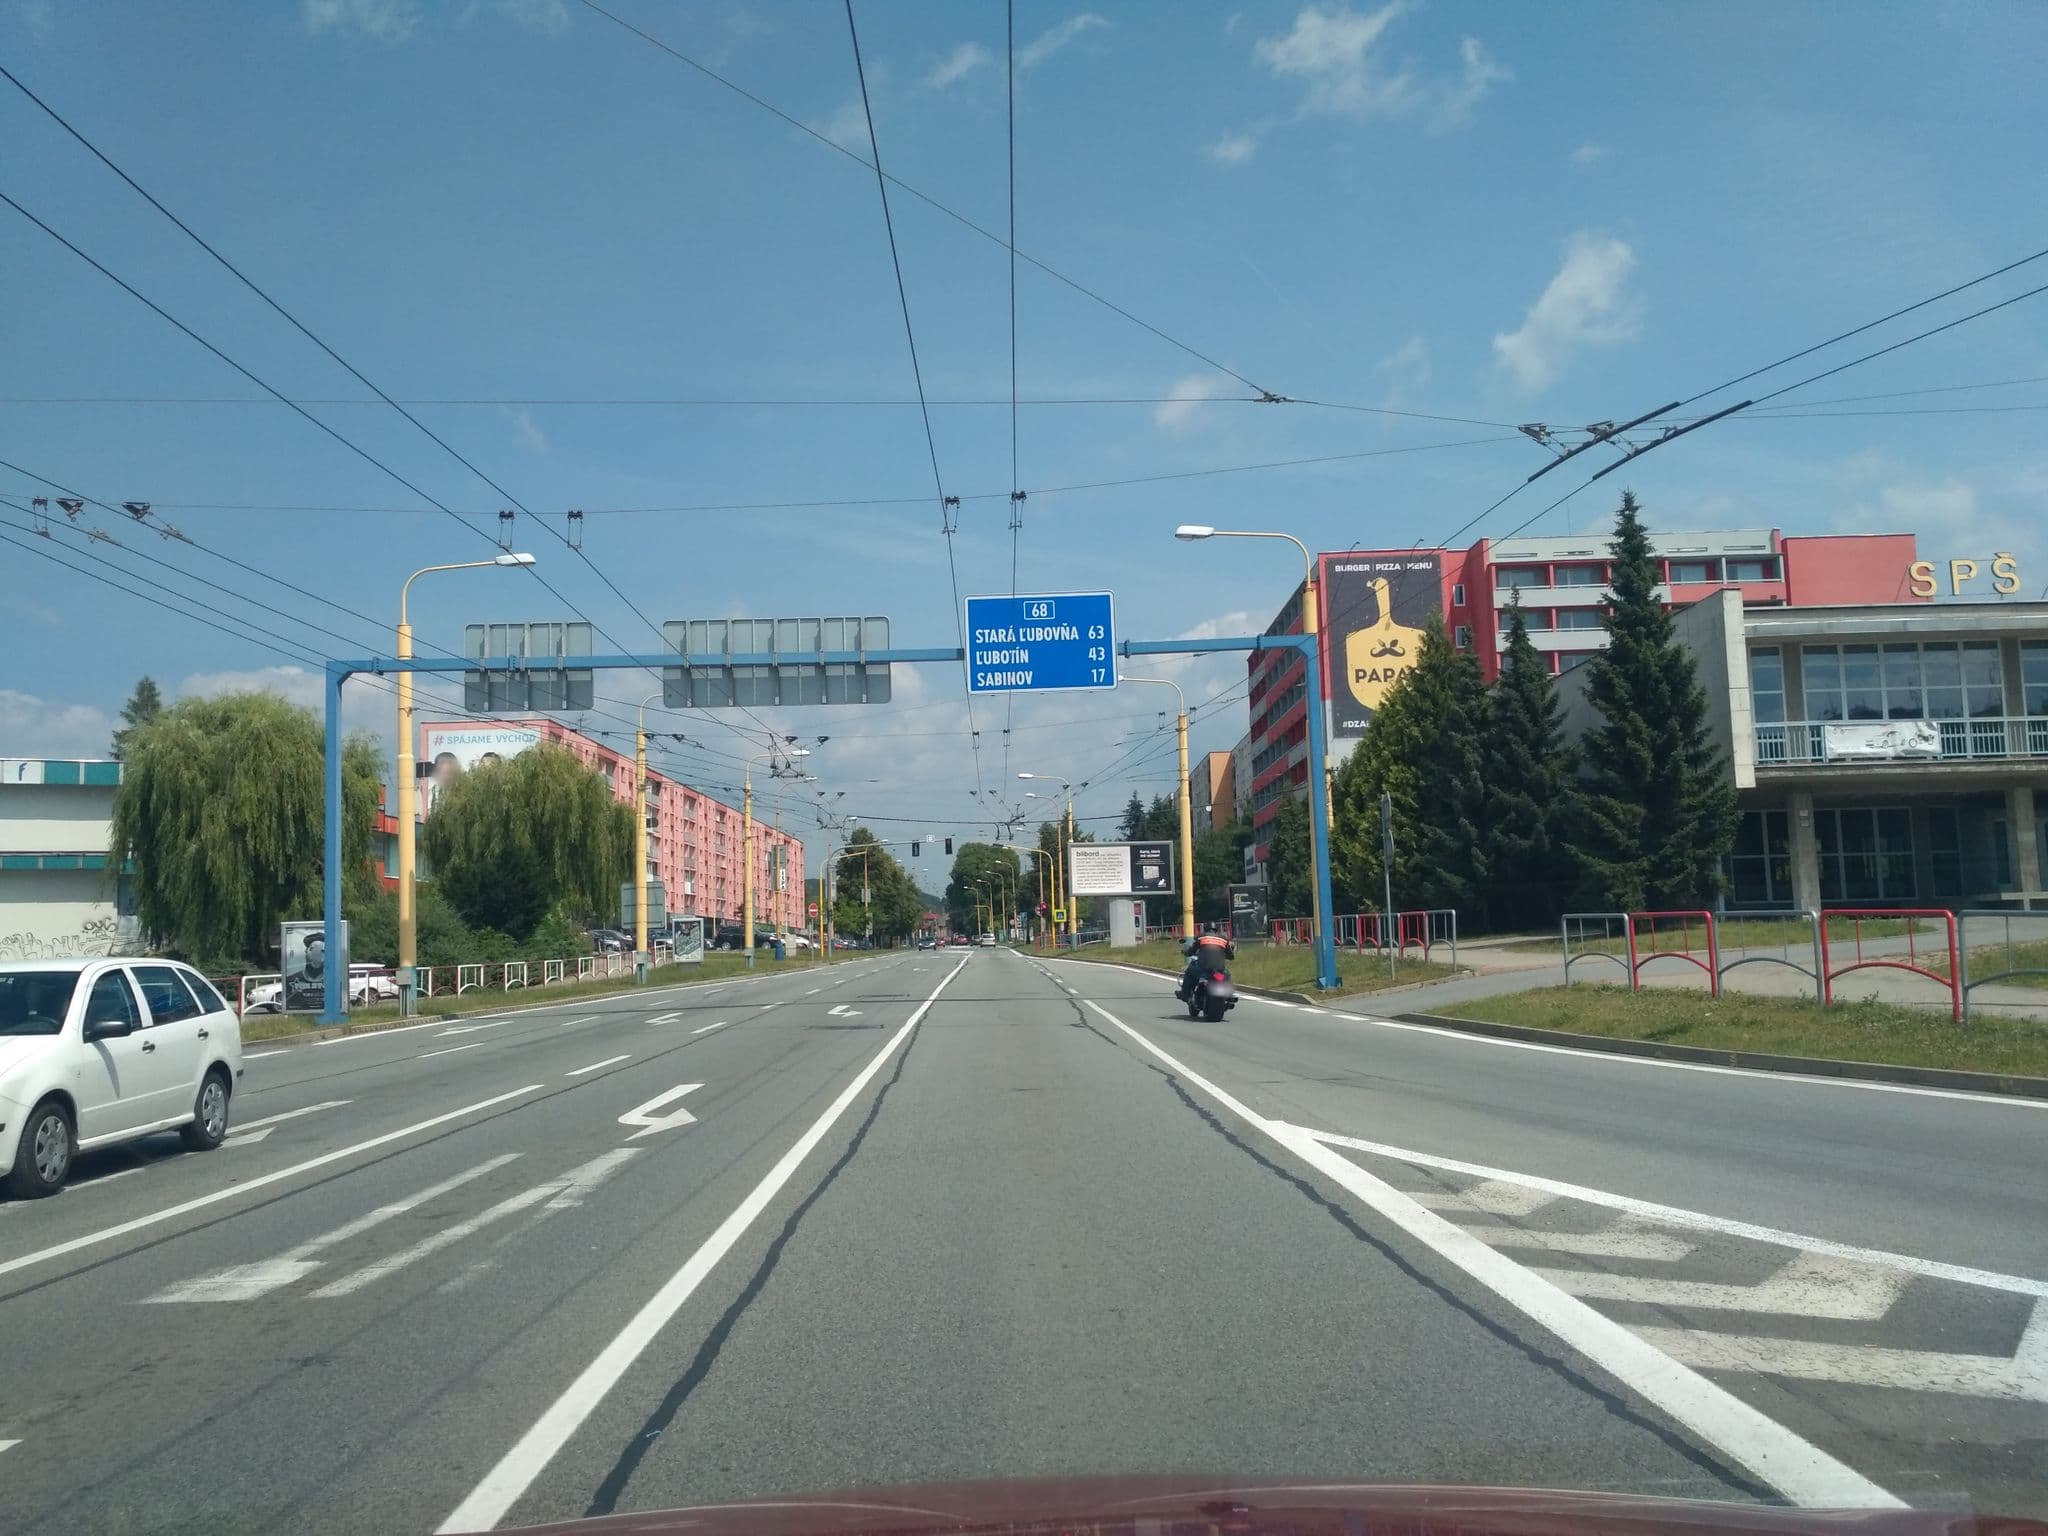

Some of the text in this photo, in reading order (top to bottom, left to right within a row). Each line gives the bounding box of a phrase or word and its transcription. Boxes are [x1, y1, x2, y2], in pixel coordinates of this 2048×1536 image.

[1335, 562, 1432, 572] BURGER PIZZA MENU
[1909, 552, 2021, 598] SPŠ
[1031, 603, 1048, 618] 68
[975, 622, 1104, 643] STARÁ ĽUBOVŇA 63
[976, 646, 1105, 665] ĽUBOTÍN 43
[977, 668, 1105, 687] SABINOV 17
